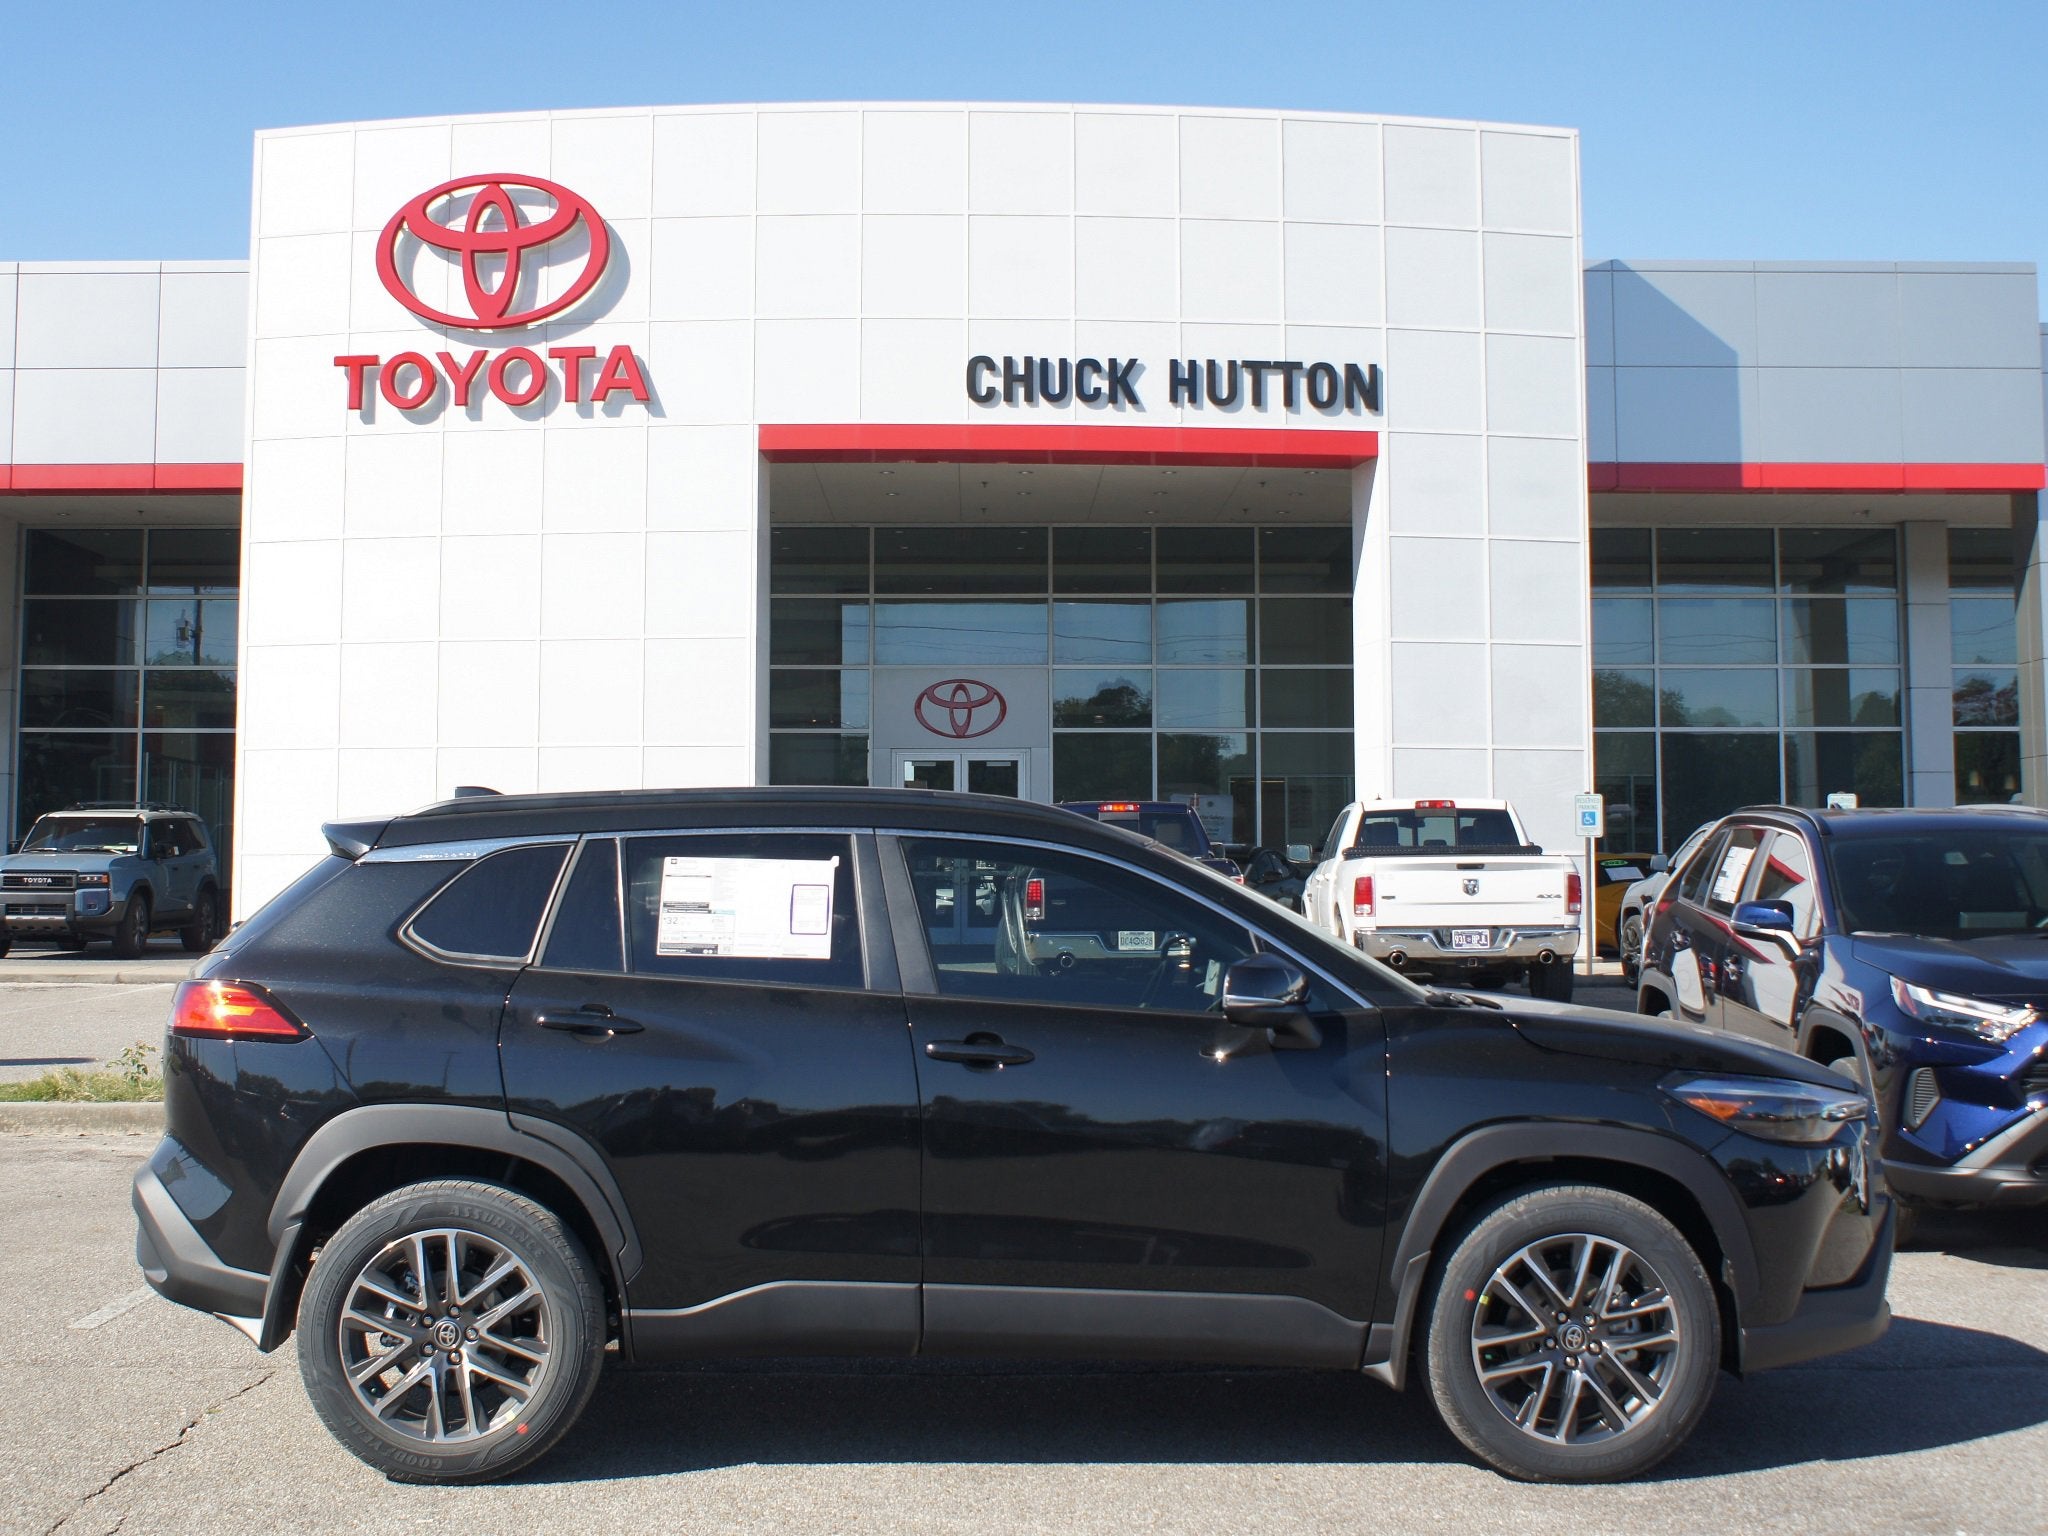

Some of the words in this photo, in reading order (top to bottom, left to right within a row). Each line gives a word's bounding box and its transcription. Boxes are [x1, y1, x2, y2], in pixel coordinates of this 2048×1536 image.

[334, 345, 650, 410] TOYOTA
[967, 355, 1140, 405] CHUCK
[1169, 358, 1379, 411] HUTTON
[448, 1204, 545, 1259] ASSURANCE
[343, 1414, 443, 1471] GOODYEAR
